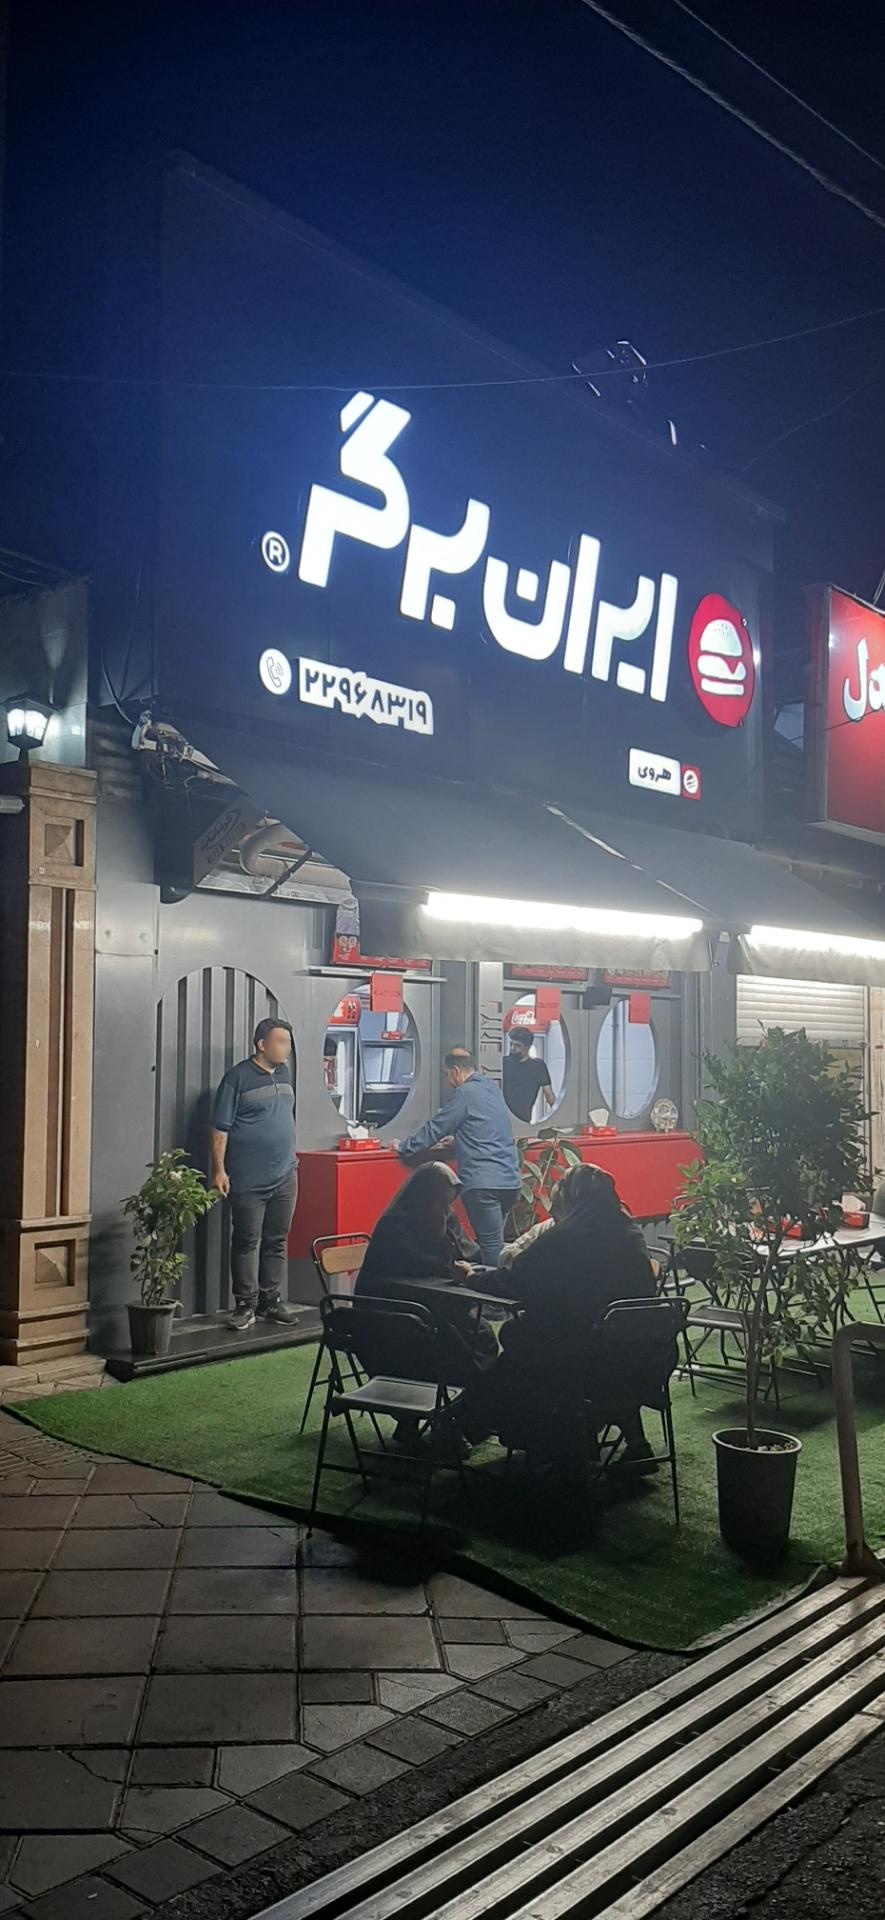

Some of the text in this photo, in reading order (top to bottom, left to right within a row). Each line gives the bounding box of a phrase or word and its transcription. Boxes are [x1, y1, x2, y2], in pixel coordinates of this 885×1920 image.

[298, 390, 491, 631] برگر
[483, 533, 679, 703] ایران
[304, 667, 428, 726] ۲۲۹۶۸۳۱۹
[637, 765, 672, 783] هروی
